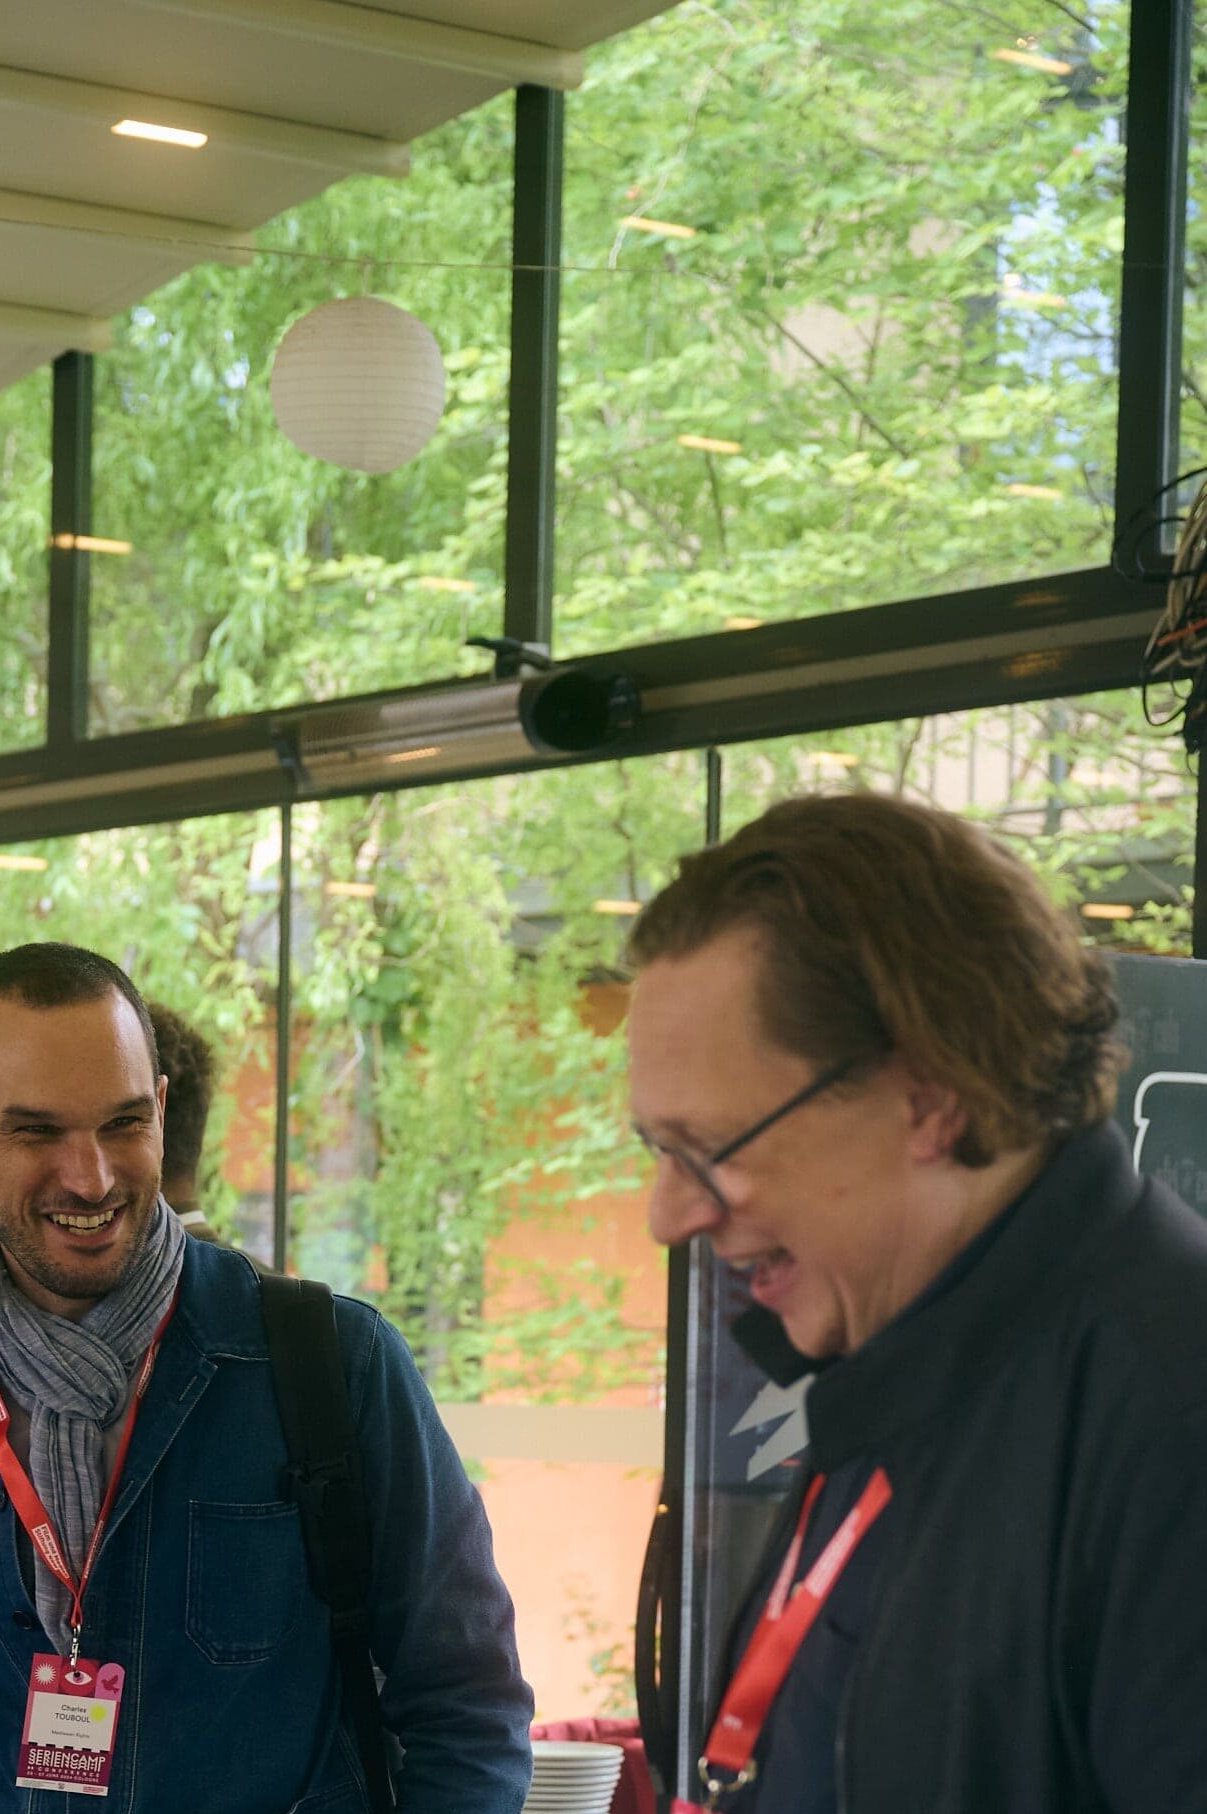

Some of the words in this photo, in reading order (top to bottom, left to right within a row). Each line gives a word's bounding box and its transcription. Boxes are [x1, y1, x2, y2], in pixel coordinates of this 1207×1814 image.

[61, 1704, 87, 1714] Charles
[55, 1712, 90, 1723] TOUBOUL
[28, 1748, 106, 1772] SERIENCAMP
